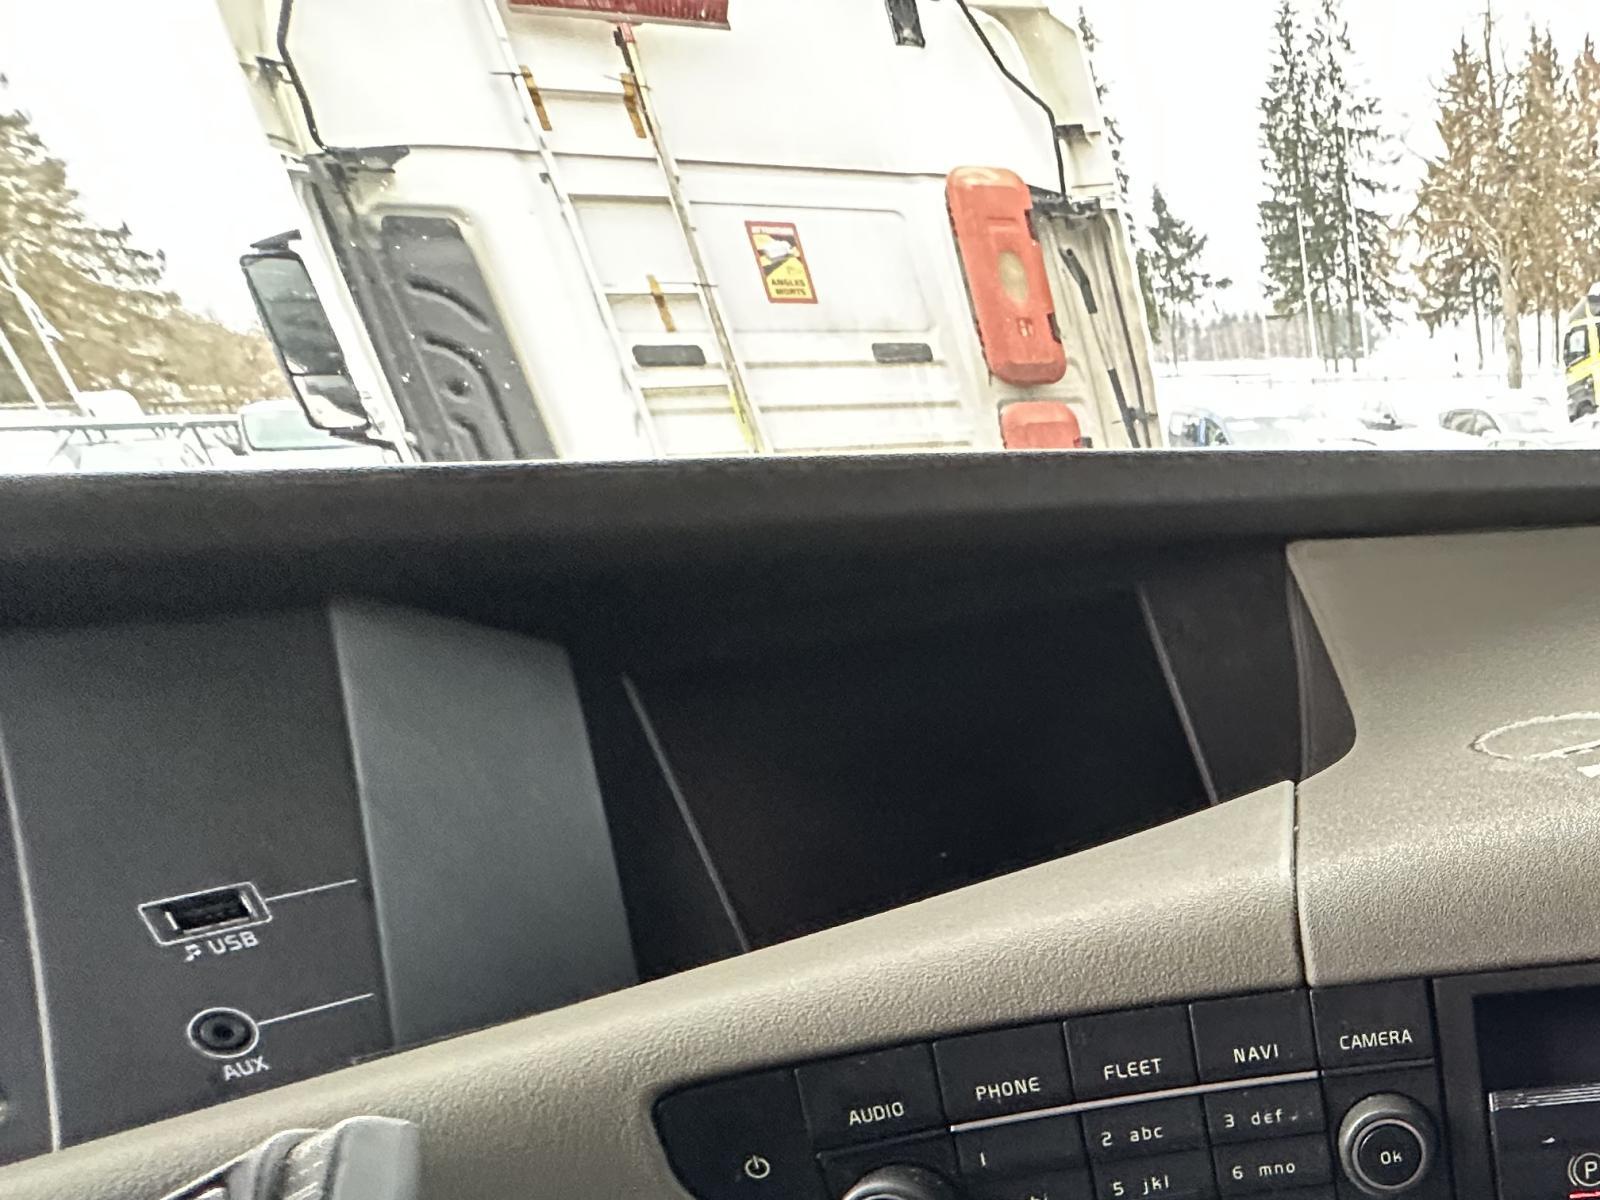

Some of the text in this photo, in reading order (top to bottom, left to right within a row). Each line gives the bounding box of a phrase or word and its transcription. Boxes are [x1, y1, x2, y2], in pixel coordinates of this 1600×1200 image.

[207, 931, 259, 956] USB
[1339, 1028, 1413, 1050] CAMERA
[1233, 1043, 1279, 1064] NAVI
[222, 1055, 270, 1081] AUX
[1103, 1057, 1161, 1081] FLEET
[975, 1076, 1041, 1099] PHONE
[849, 1101, 905, 1126] AUDIO
[1224, 1108, 1282, 1128] 3 def
[1101, 1126, 1163, 1147] 2 abc
[1232, 1162, 1296, 1180] 6 mno
[1112, 1175, 1169, 1197] 5 jkl
